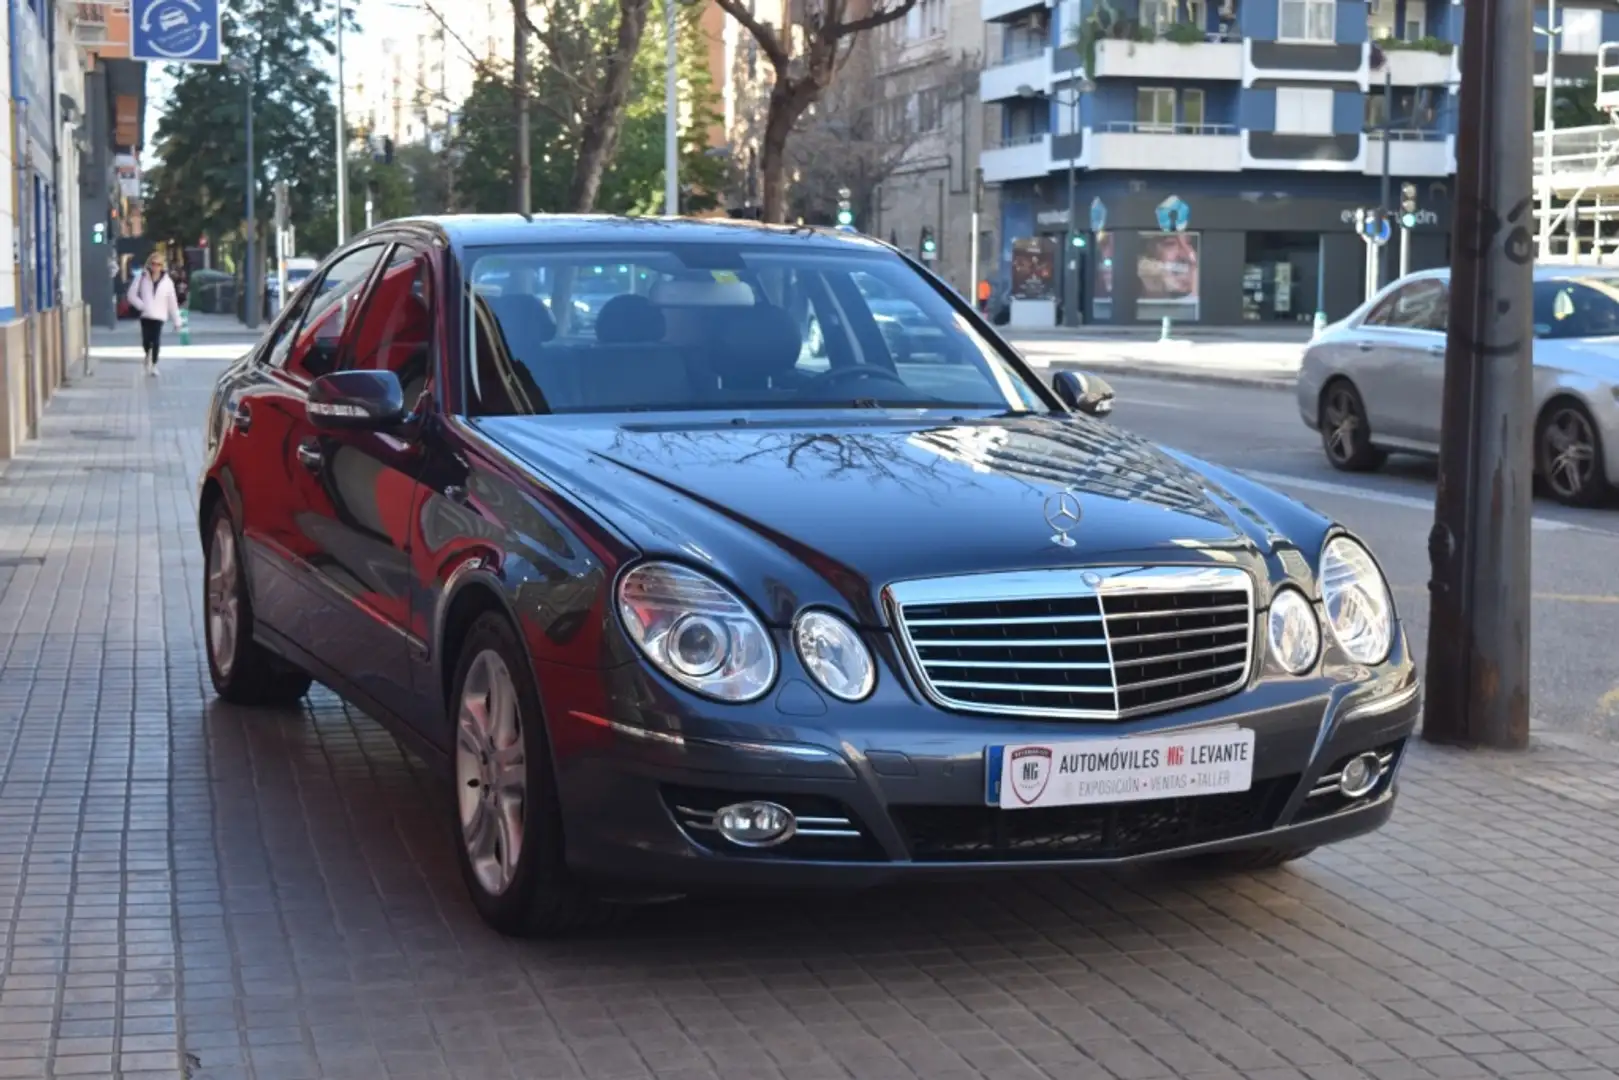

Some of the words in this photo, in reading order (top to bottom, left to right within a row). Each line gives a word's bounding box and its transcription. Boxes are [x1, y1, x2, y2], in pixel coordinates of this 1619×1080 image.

[1022, 762, 1039, 781] NG
[1059, 747, 1159, 774] AUTOMÓVILES
[1166, 745, 1185, 766] NG
[1190, 742, 1249, 765] LEVANTE
[1078, 775, 1140, 797] EXPOSICIÓN
[1150, 773, 1187, 791] VENTAS
[1196, 769, 1231, 788] TALLER
